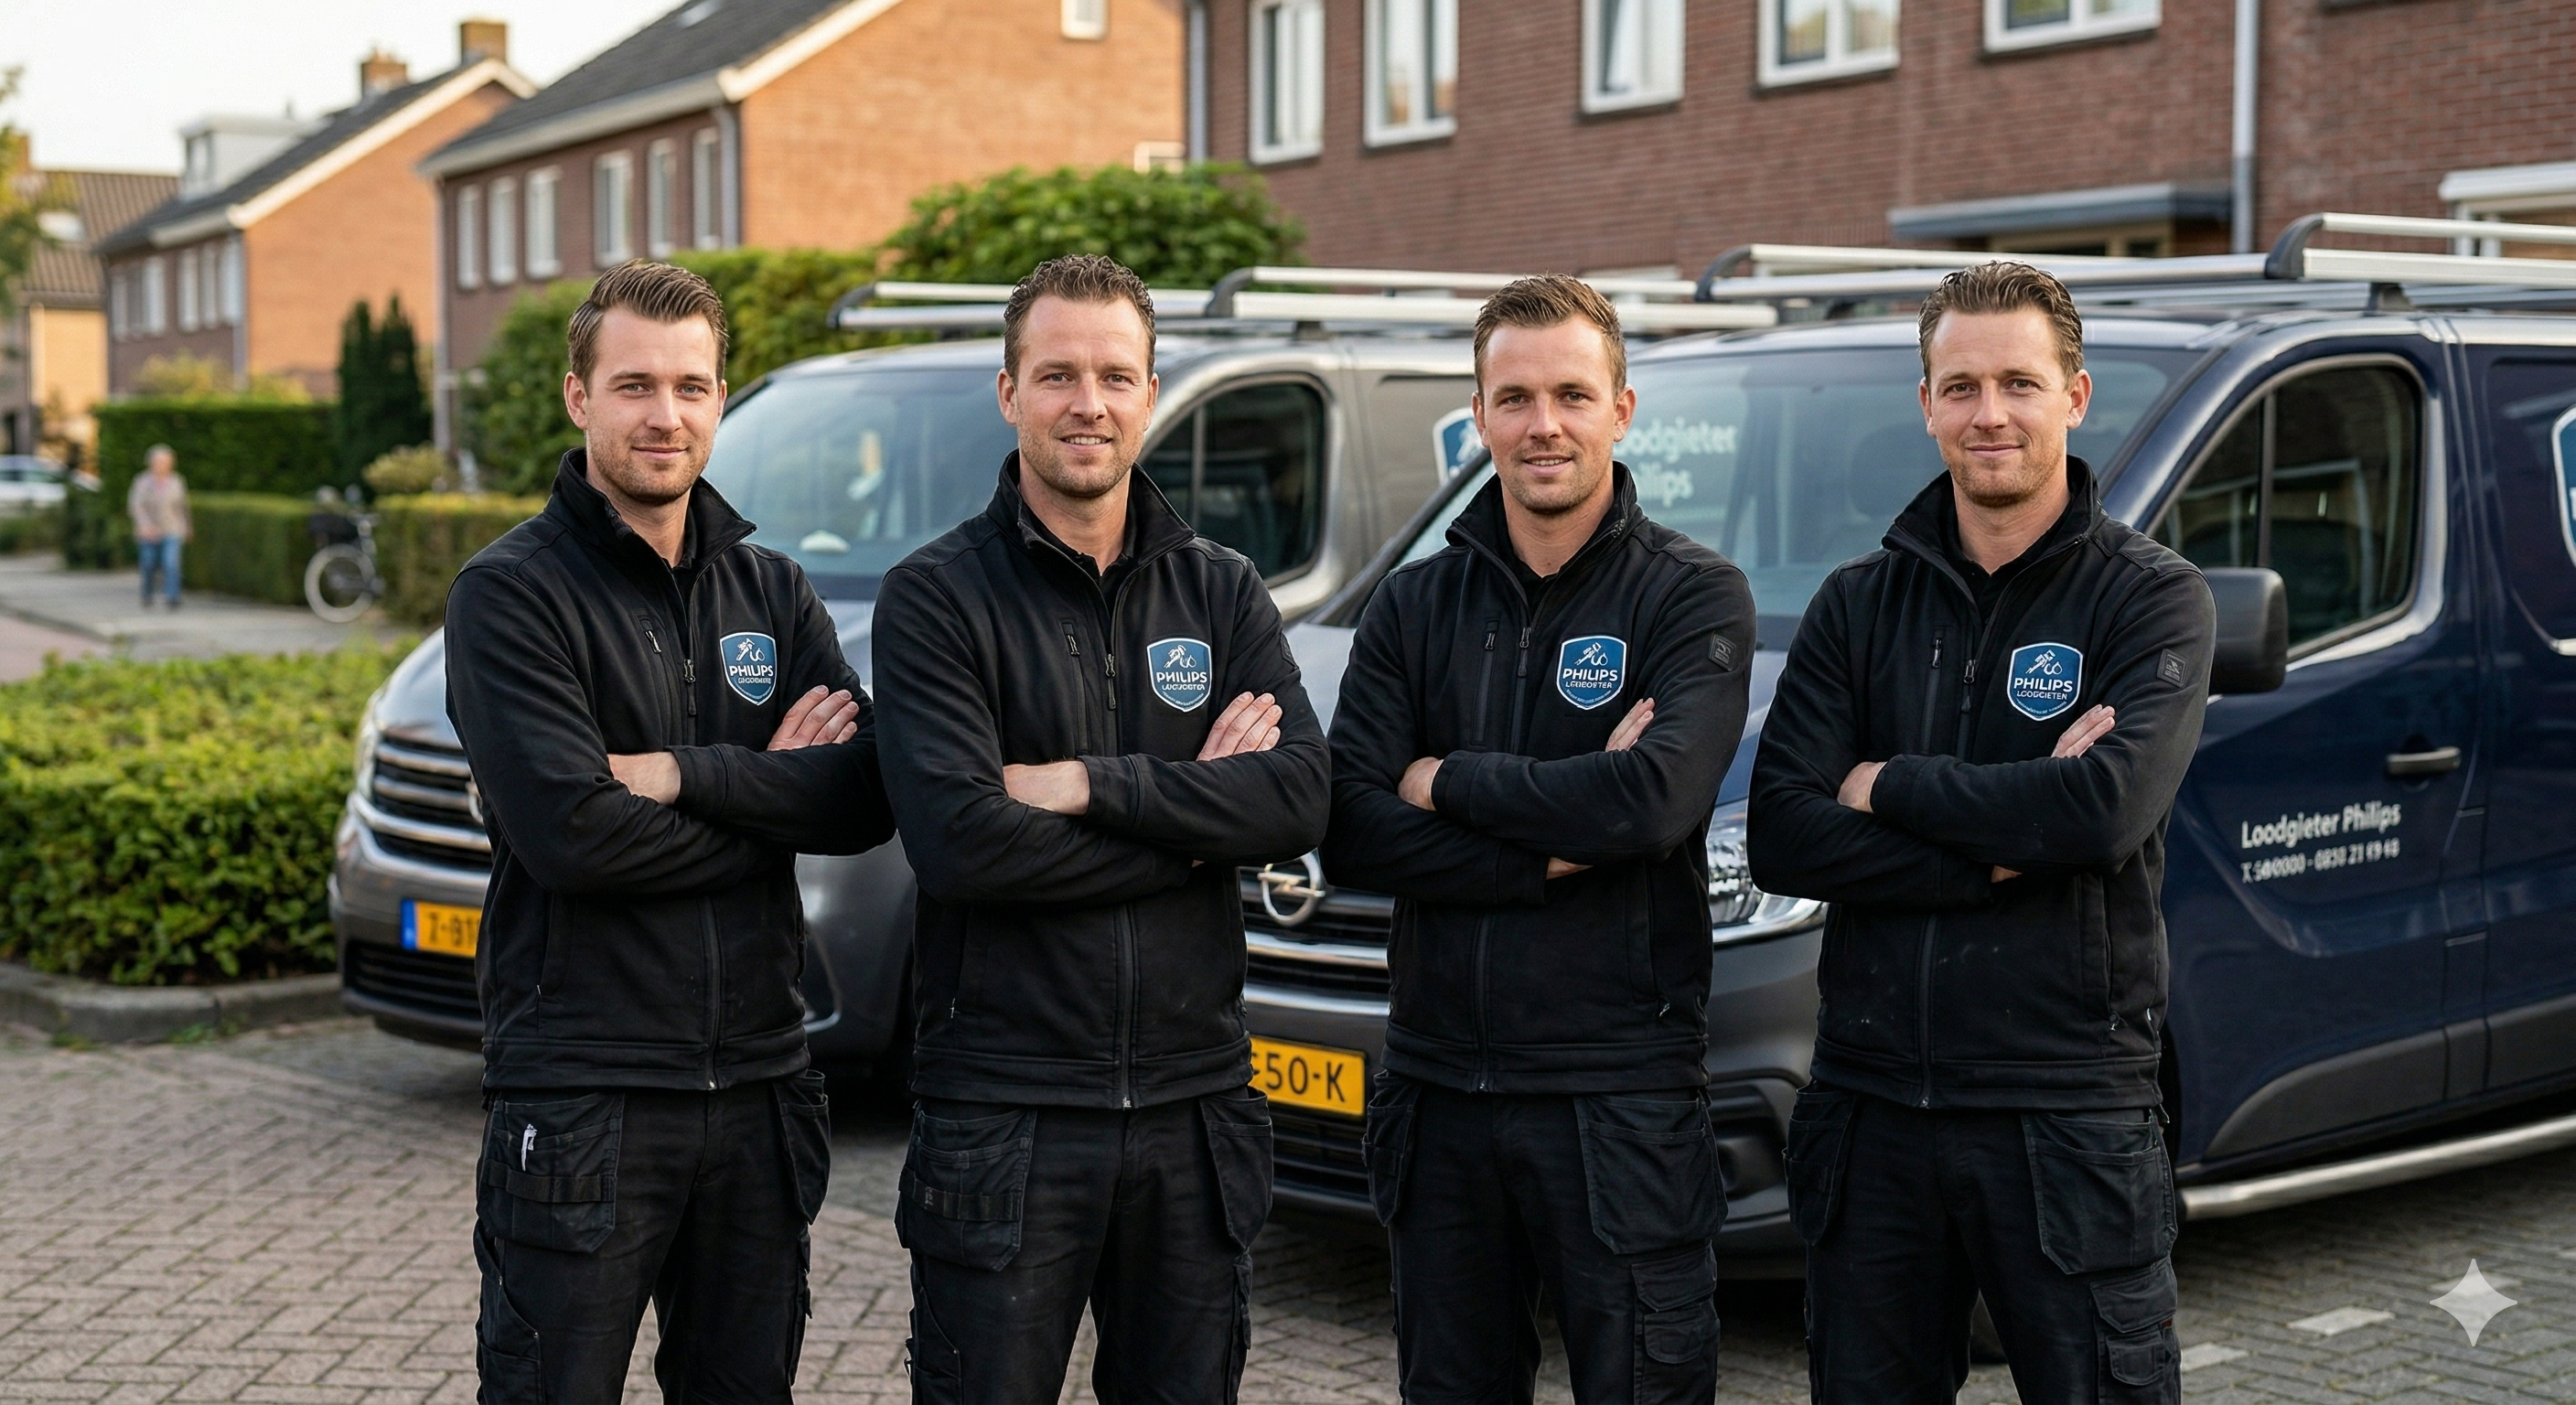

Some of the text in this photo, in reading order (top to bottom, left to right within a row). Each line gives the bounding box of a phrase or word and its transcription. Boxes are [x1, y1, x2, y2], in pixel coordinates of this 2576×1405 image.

[1156, 671, 1208, 683] PHILIPS
[1562, 668, 1618, 681] PHILIPS
[2013, 677, 2074, 692] PHILIPS
[2241, 799, 2401, 849] Loodgieter Philips
